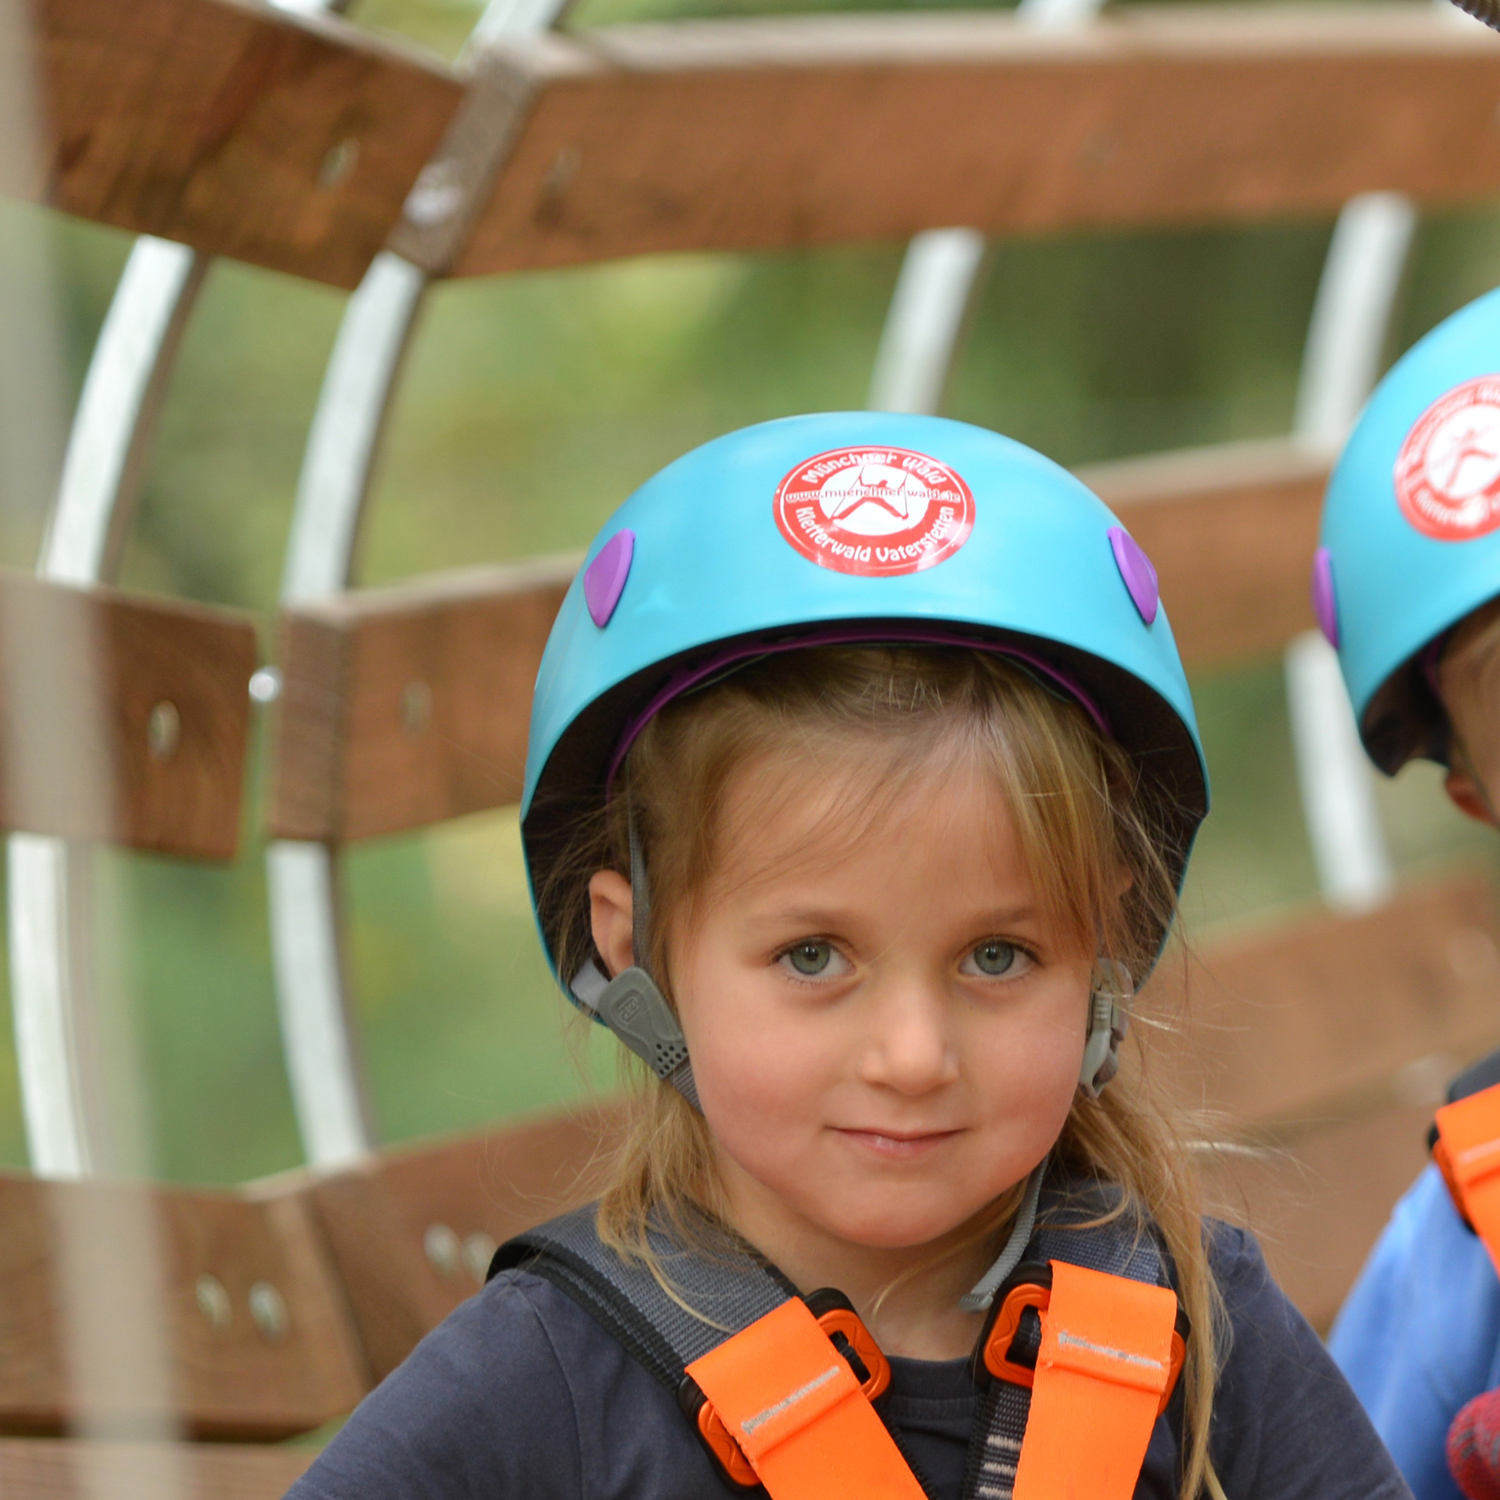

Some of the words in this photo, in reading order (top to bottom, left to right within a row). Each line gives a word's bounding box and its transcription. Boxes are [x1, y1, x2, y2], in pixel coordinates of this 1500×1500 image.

[801, 452, 897, 484] Münchner
[902, 456, 947, 485] Wald
[795, 506, 871, 562] Kletterwald
[875, 506, 954, 562] Vaterstetten
